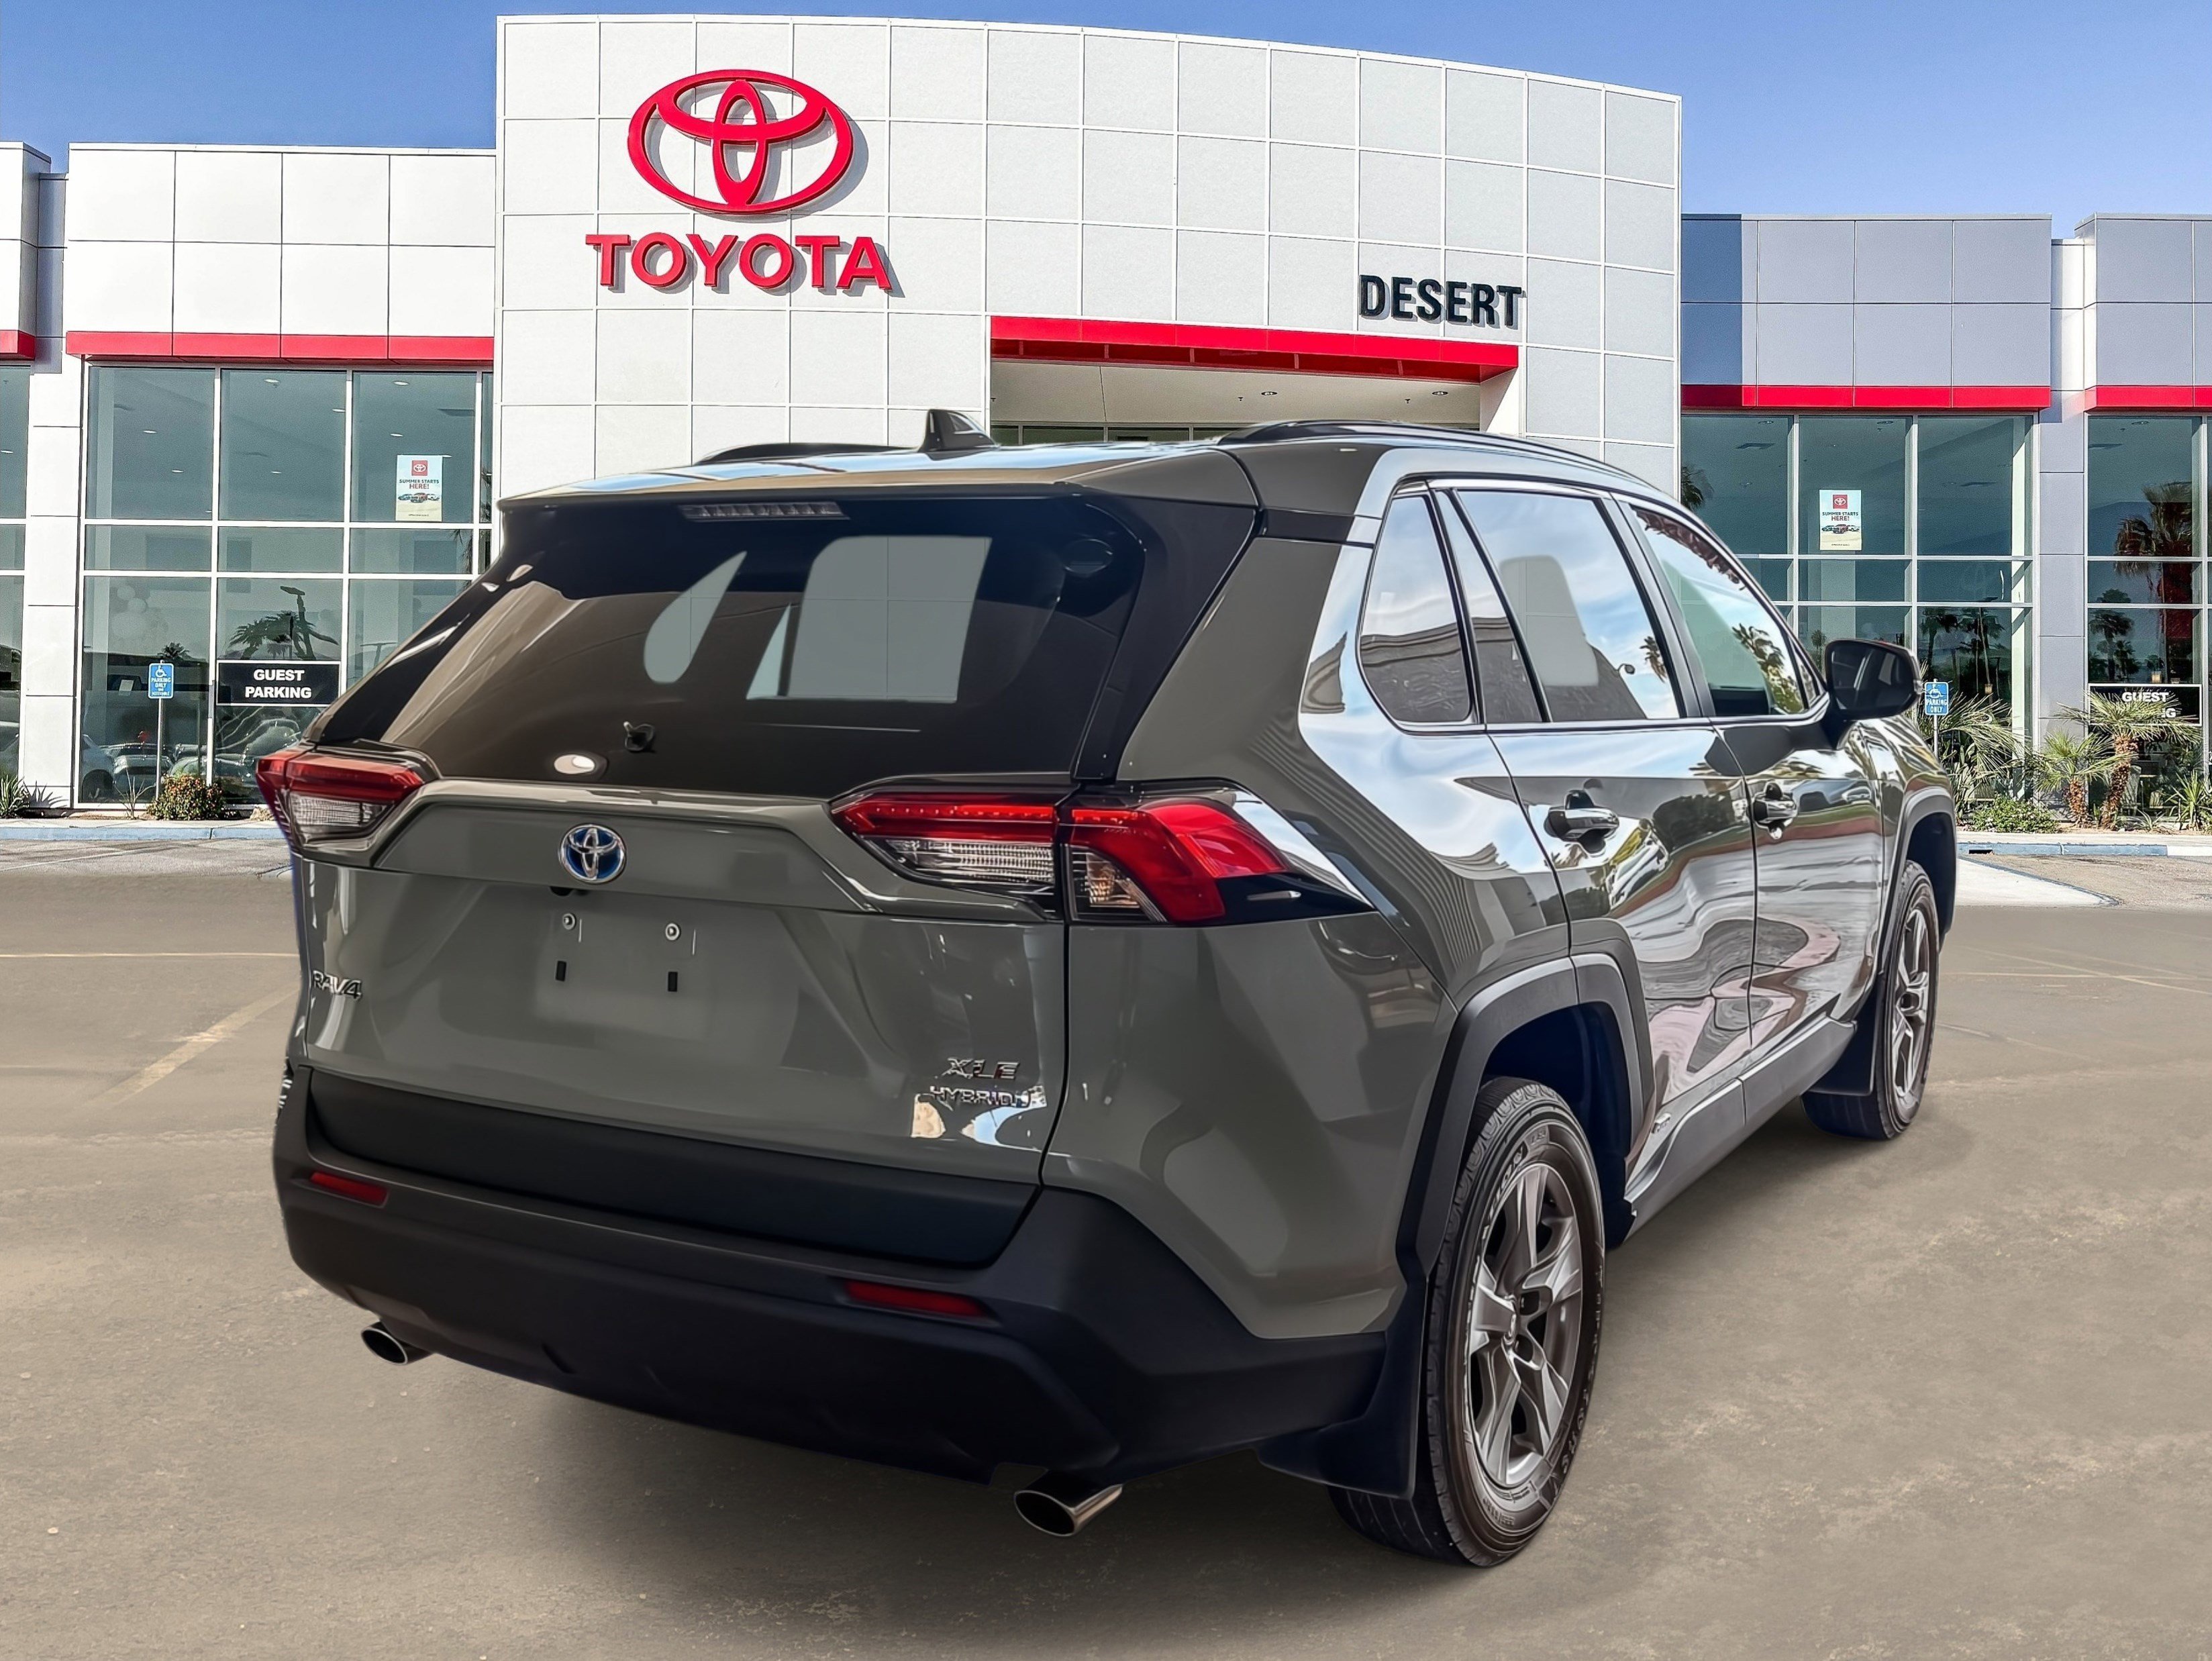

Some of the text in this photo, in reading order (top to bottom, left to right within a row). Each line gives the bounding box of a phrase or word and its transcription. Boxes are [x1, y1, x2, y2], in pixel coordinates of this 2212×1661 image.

[586, 232, 892, 290] TOYOTA
[1359, 274, 1522, 327] DESERT
[253, 669, 305, 681] GUEST
[245, 686, 311, 699] PARKING
[2121, 691, 2169, 703] GUEST
[1930, 705, 1944, 713] ONLY
[313, 970, 363, 1000] RAV4
[942, 1057, 1019, 1080] XLE
[930, 1085, 1016, 1107] HYBRID
